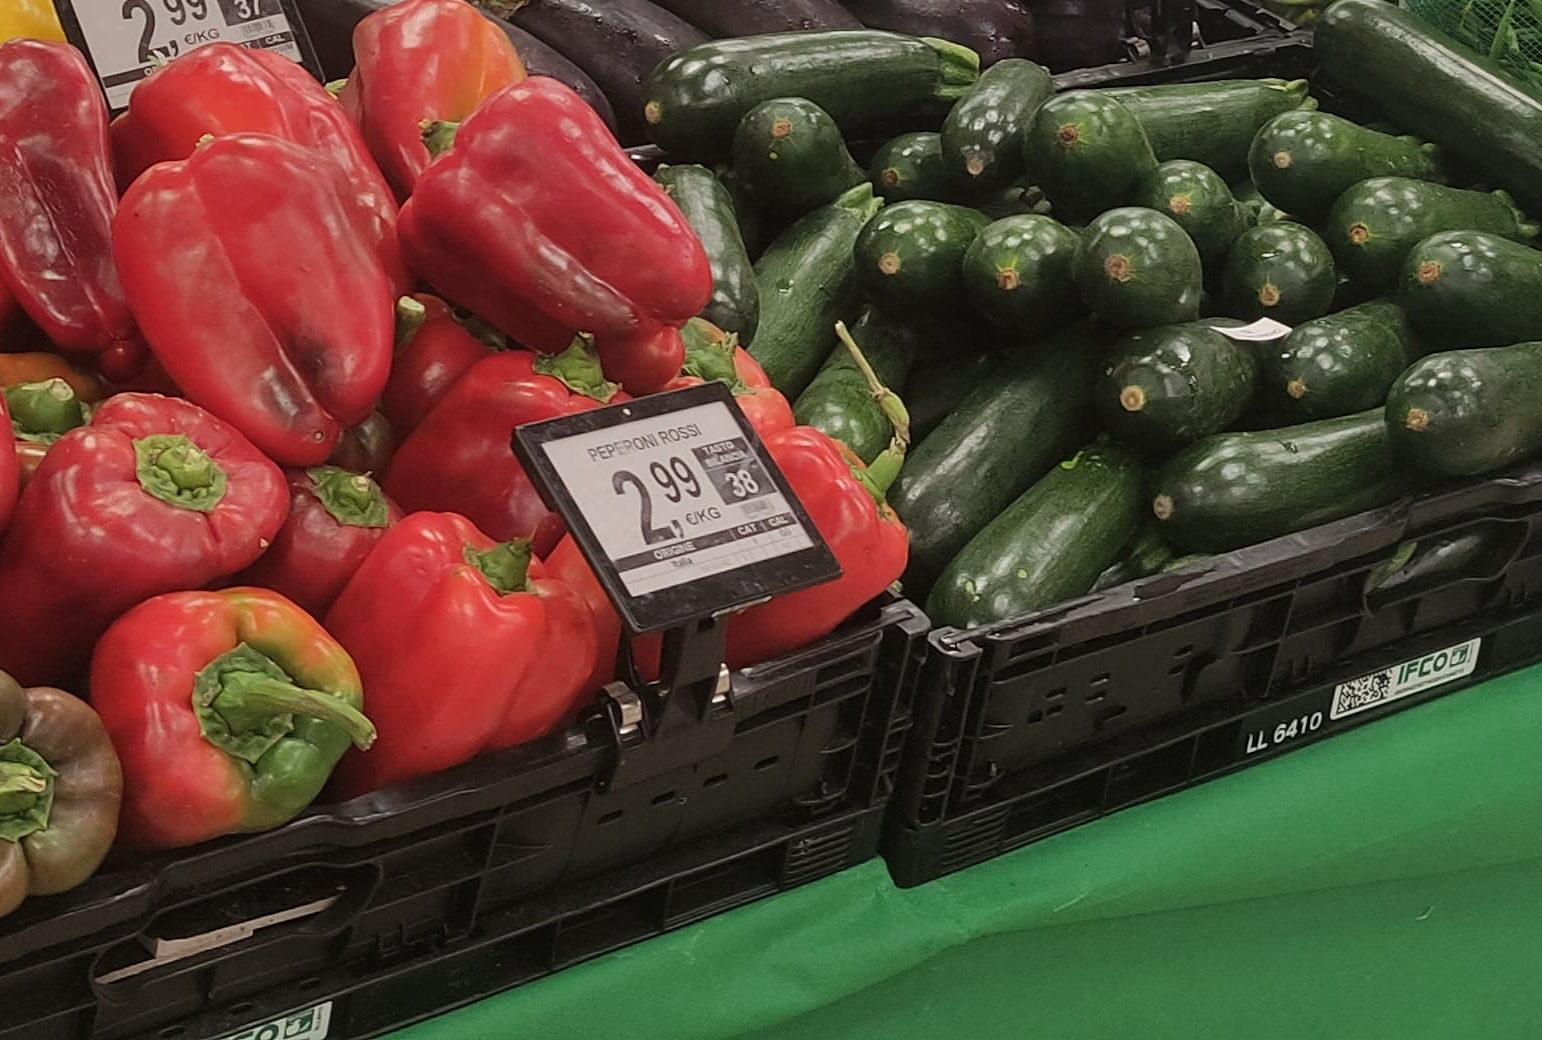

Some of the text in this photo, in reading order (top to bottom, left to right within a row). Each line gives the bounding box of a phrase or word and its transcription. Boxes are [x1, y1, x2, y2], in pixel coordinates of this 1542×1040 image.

[183, 27, 221, 46] €/KG
[587, 422, 703, 463] PEPERONI ROSSI
[702, 441, 735, 455] TASTO
[724, 468, 761, 498] 38
[611, 455, 702, 547] 2,99
[685, 506, 722, 526] €/KG
[737, 522, 759, 536] CAT
[654, 541, 696, 561] ORIGINE
[1246, 731, 1269, 754] LL
[1273, 711, 1324, 745] 6410
[1396, 652, 1449, 686] IFCO
